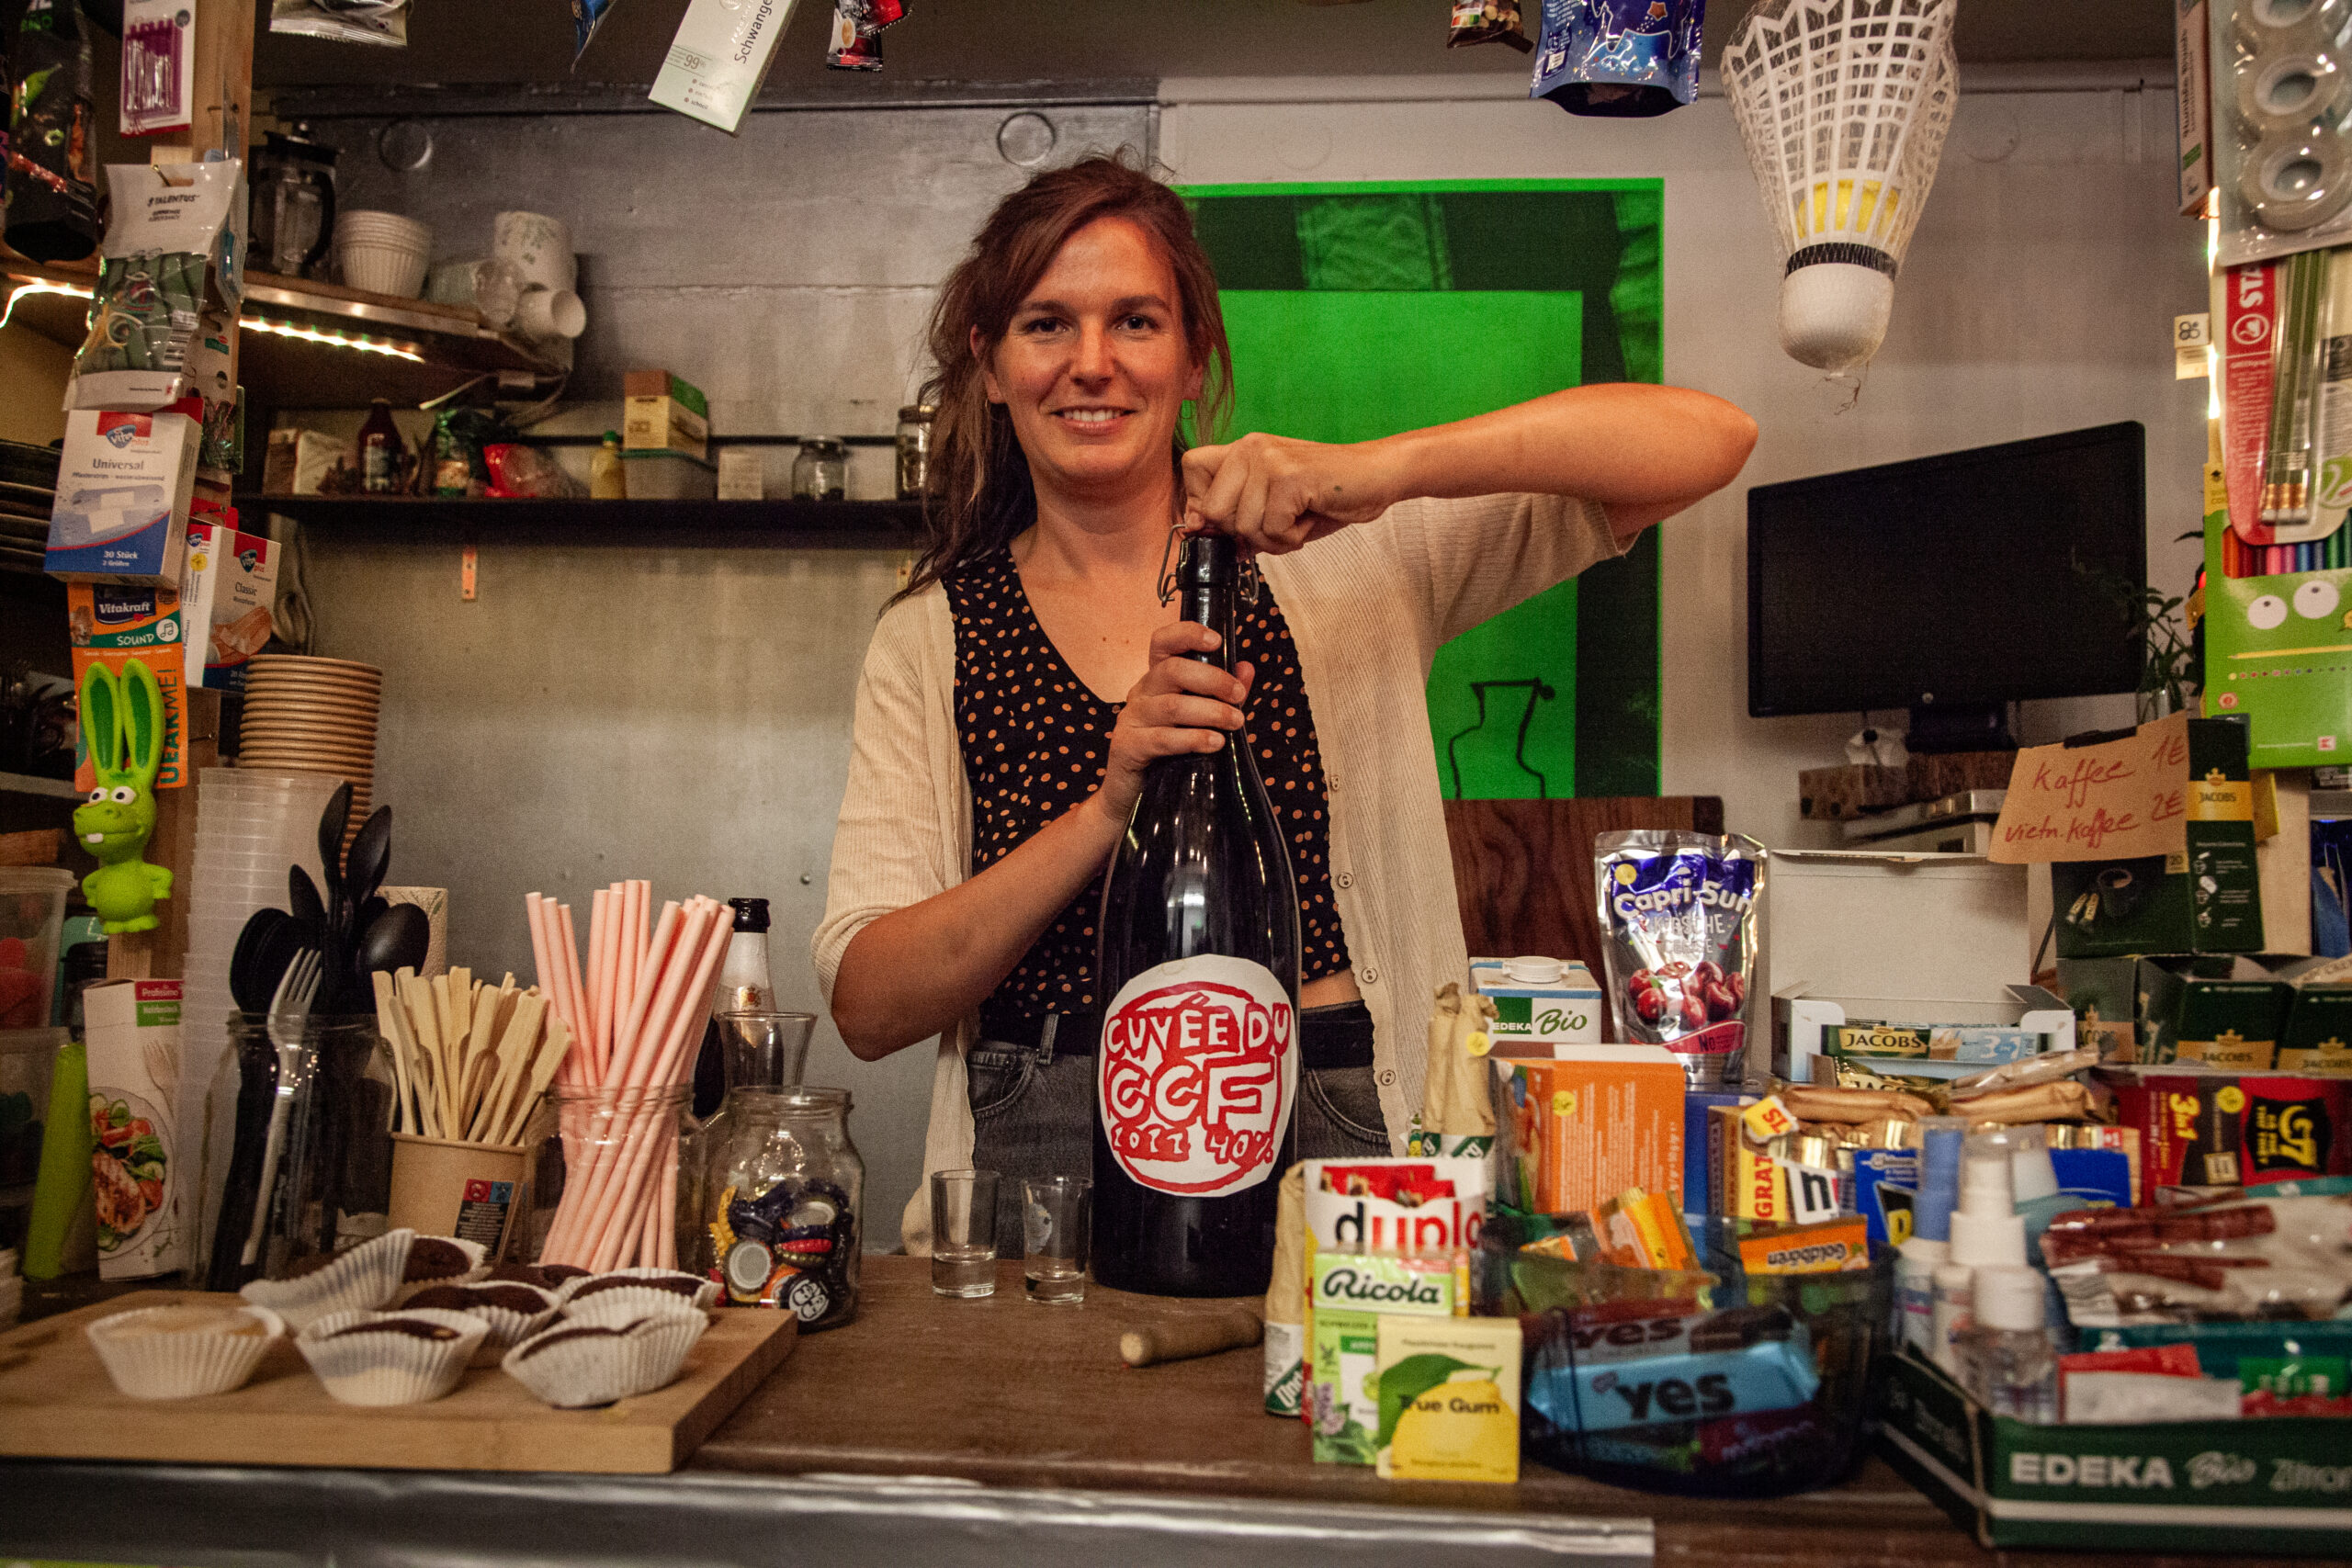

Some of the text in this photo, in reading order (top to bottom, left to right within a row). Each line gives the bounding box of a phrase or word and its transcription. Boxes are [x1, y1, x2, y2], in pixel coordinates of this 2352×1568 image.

[93, 458, 144, 470] Universal
[235, 582, 257, 596] Classic
[99, 602, 151, 614] Vitakraft
[117, 634, 154, 646] SOUND
[2199, 792, 2236, 802] JACOBS
[1492, 1009, 1588, 1035] EDEKA Bio
[1845, 1033, 1922, 1048] JACOBS
[1336, 1201, 1483, 1254] duplo
[1323, 1269, 1441, 1304] Ricola
[1615, 1374, 1735, 1419] yes
[1449, 1397, 1499, 1414] Gum
[2009, 1451, 2174, 1489] EDEKA
